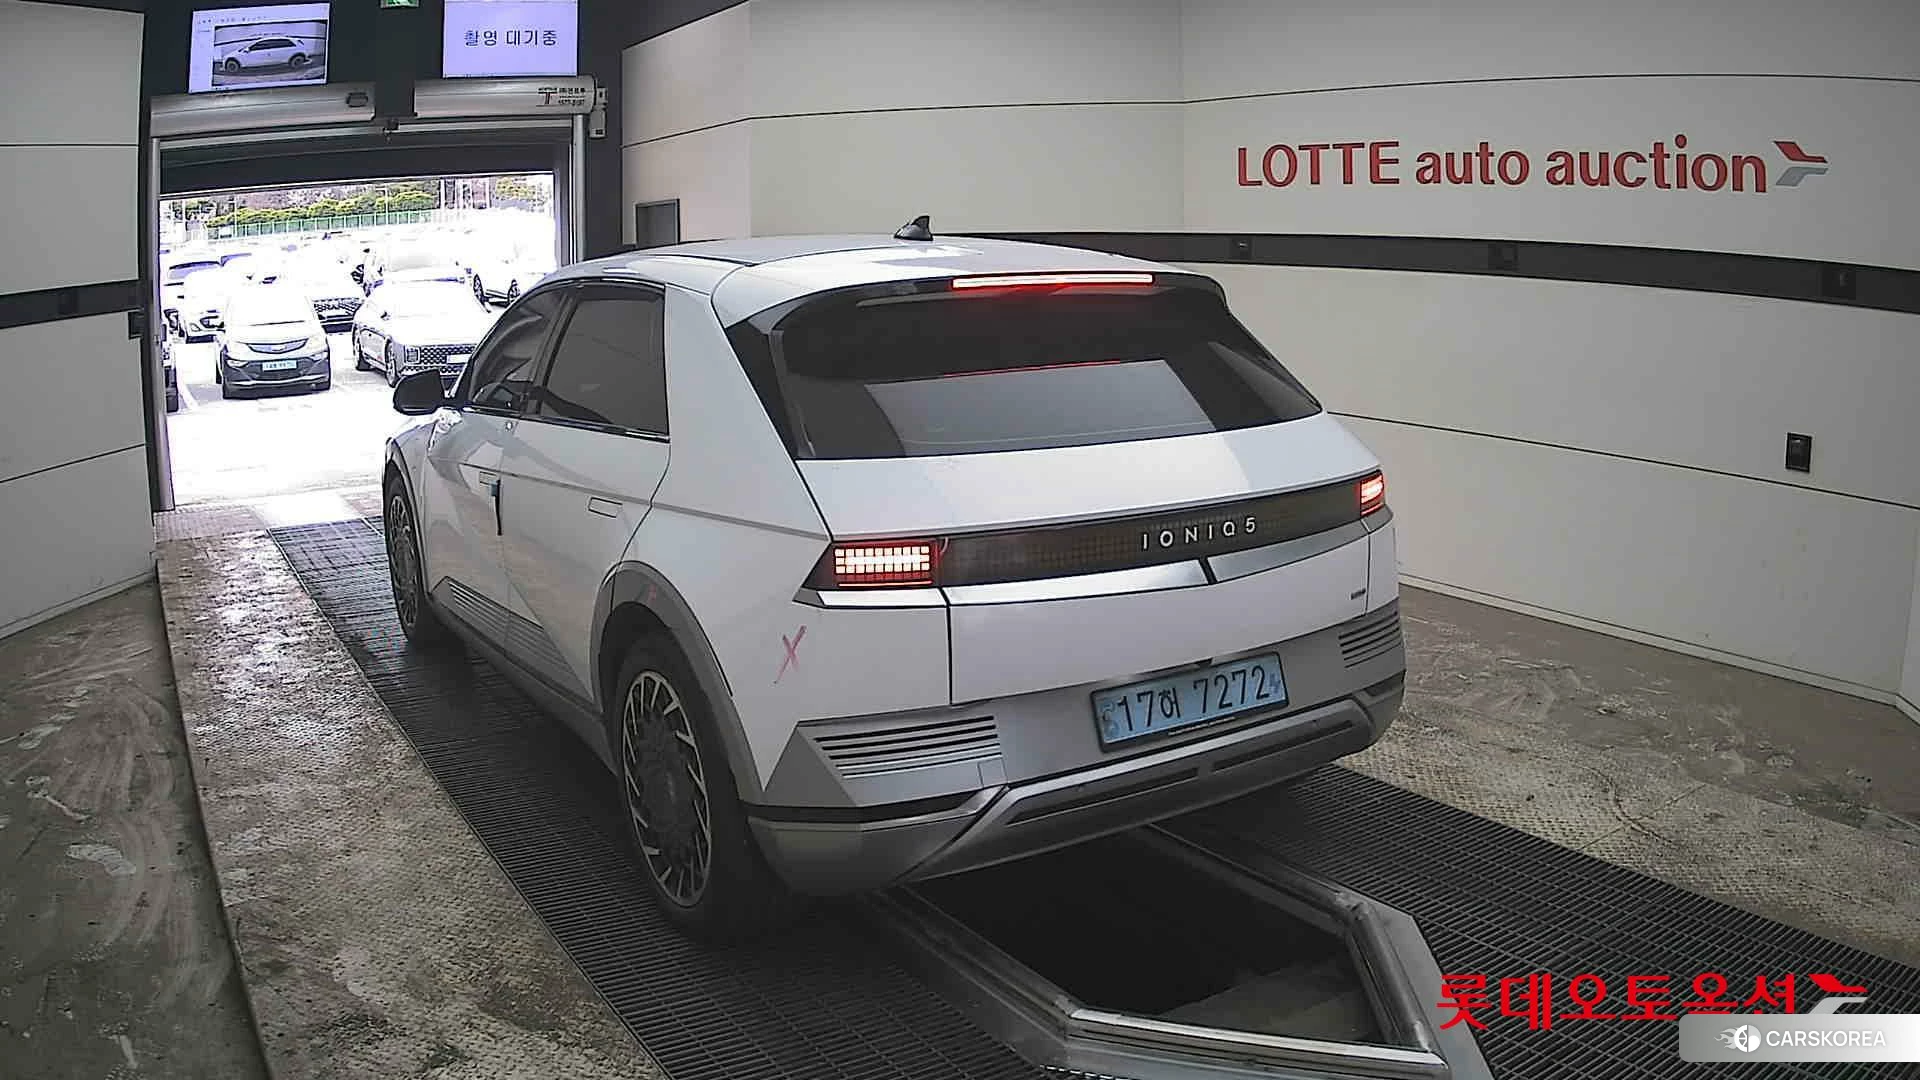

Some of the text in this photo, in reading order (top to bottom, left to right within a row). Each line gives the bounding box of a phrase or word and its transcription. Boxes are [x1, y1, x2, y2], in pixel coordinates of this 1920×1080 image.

[506, 30, 557, 46] 대기중
[1238, 134, 1767, 194] LOTTE auto auction
[1193, 665, 1269, 713] 7272
